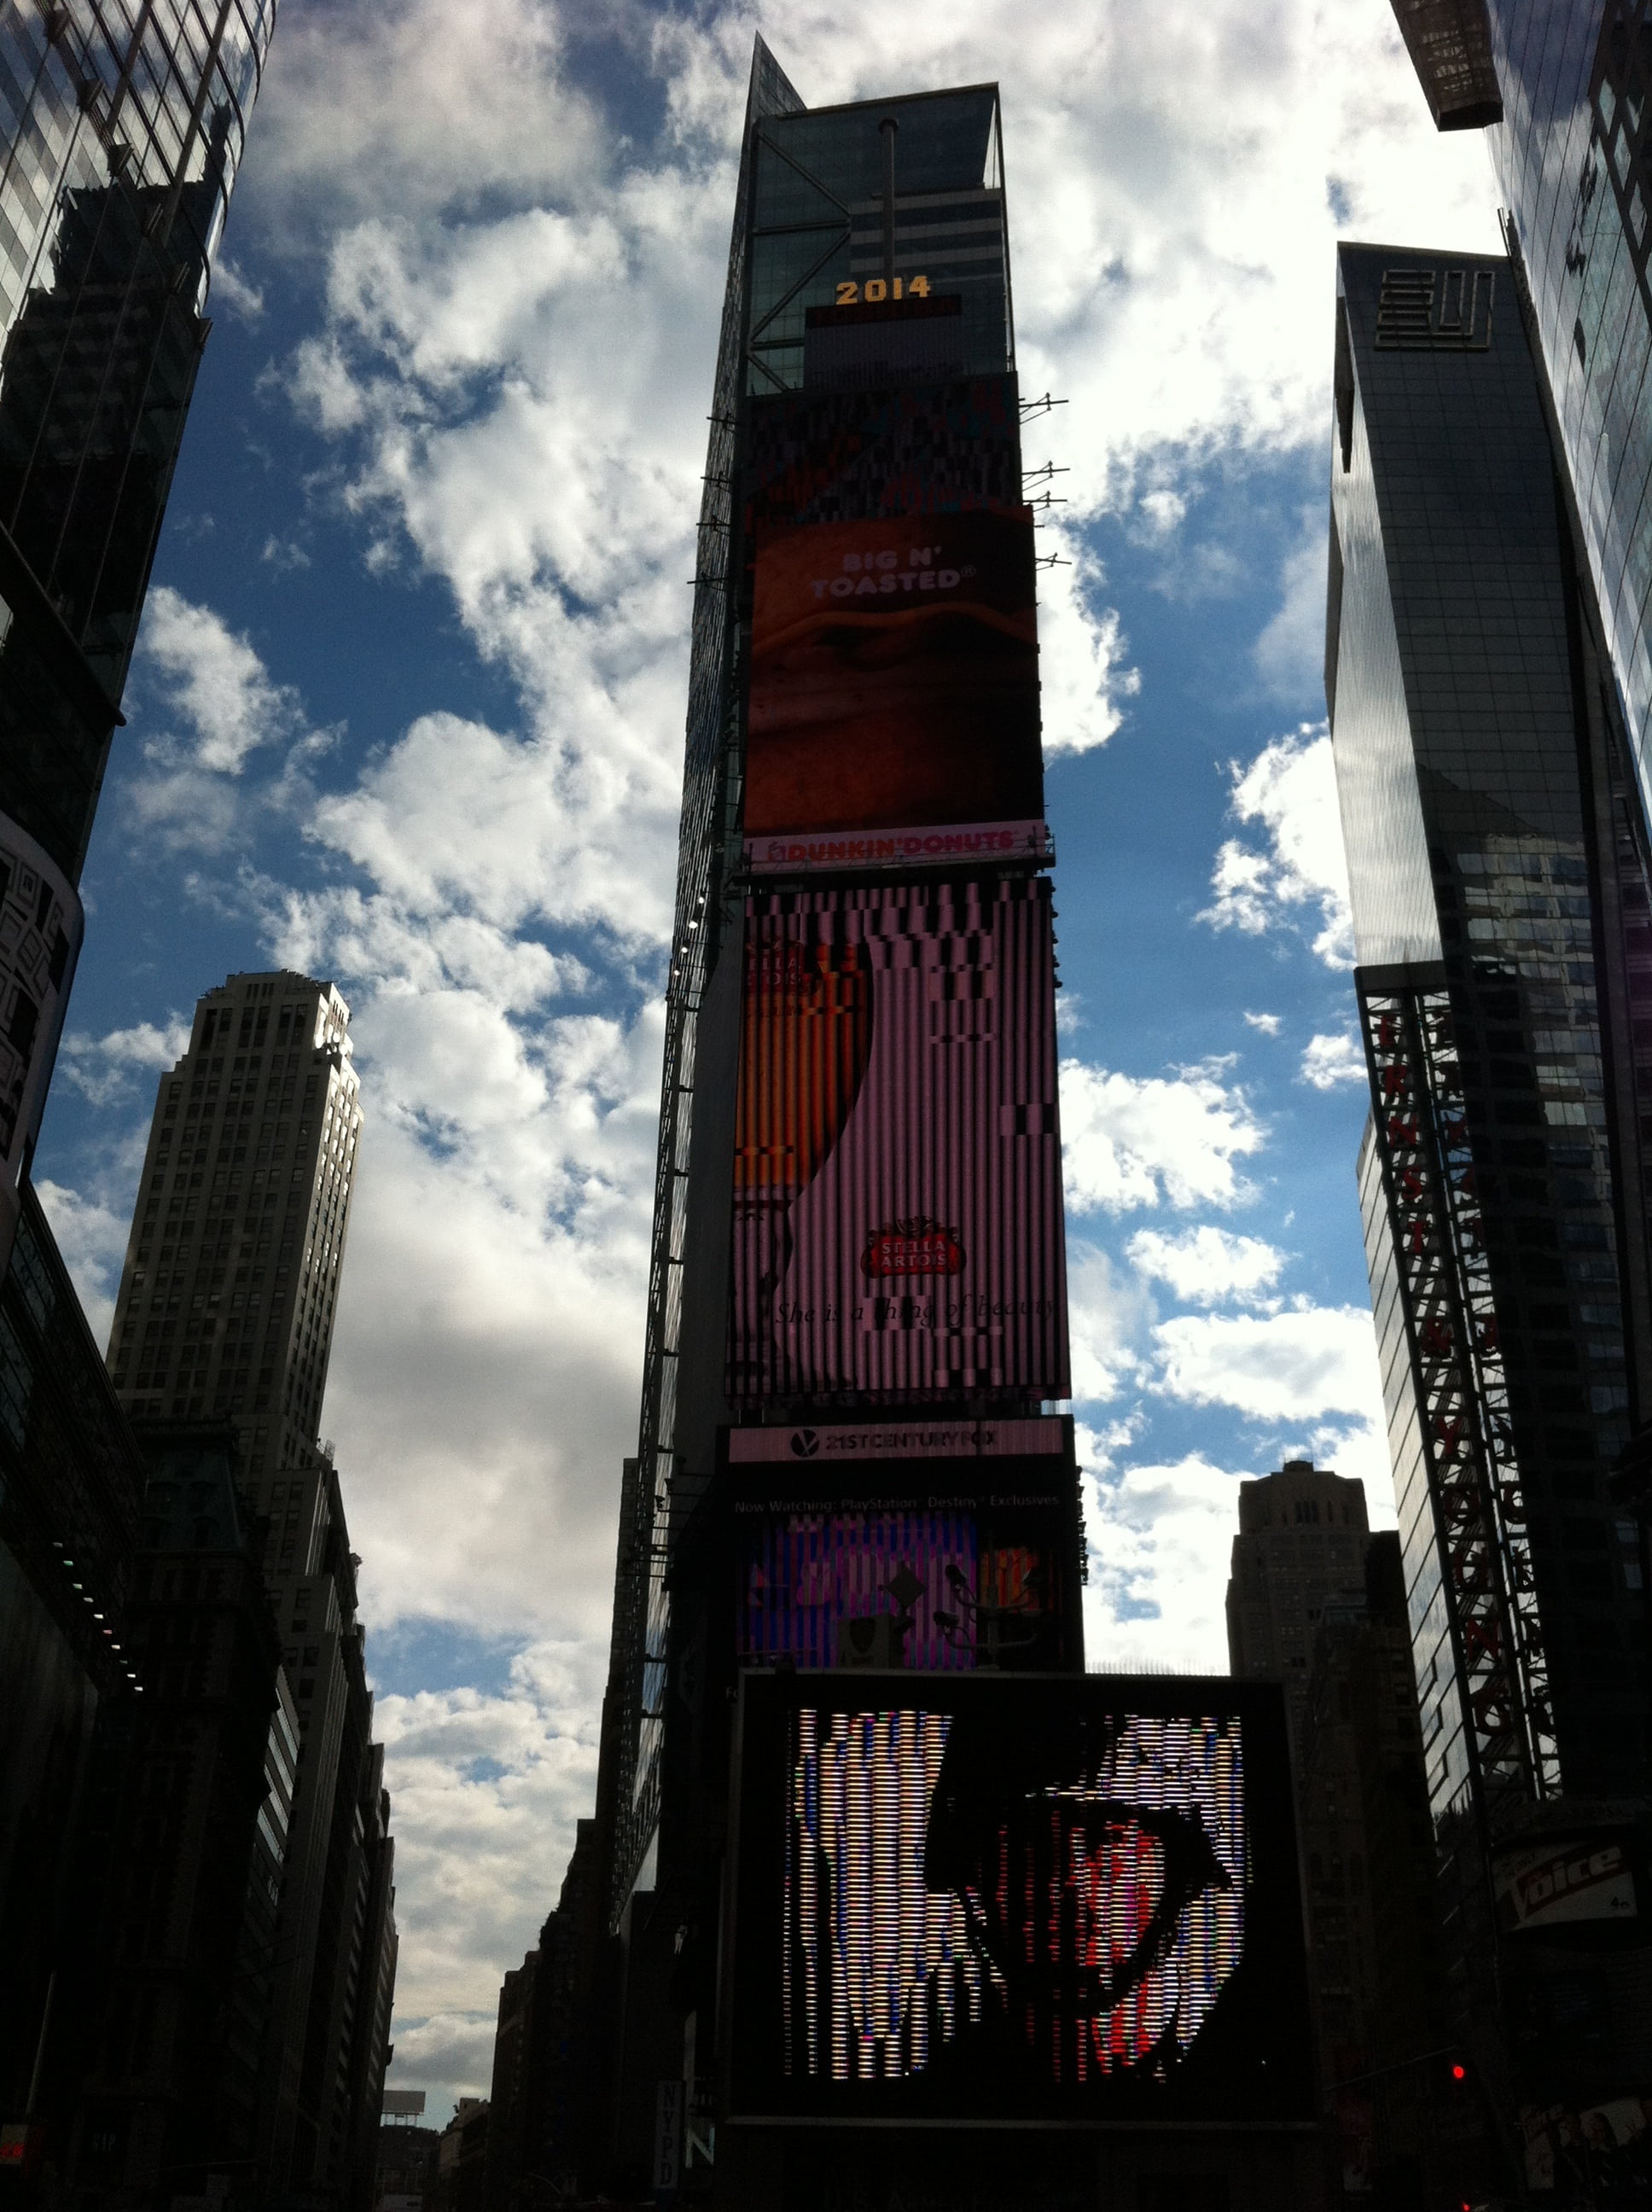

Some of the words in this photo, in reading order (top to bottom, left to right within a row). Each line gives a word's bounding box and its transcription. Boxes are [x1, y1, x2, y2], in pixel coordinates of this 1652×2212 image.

[836, 275, 931, 306] 2014
[843, 550, 899, 572] BIG
[908, 546, 943, 568] N'
[904, 830, 1015, 854] DONUTS
[881, 1240, 947, 1254] STELLA
[881, 1253, 947, 1267] ARTOIS
[775, 1301, 815, 1323] She
[735, 1501, 765, 1513] Now
[990, 1494, 1060, 1509] Exclusives
[660, 2082, 676, 2186] NYPD
